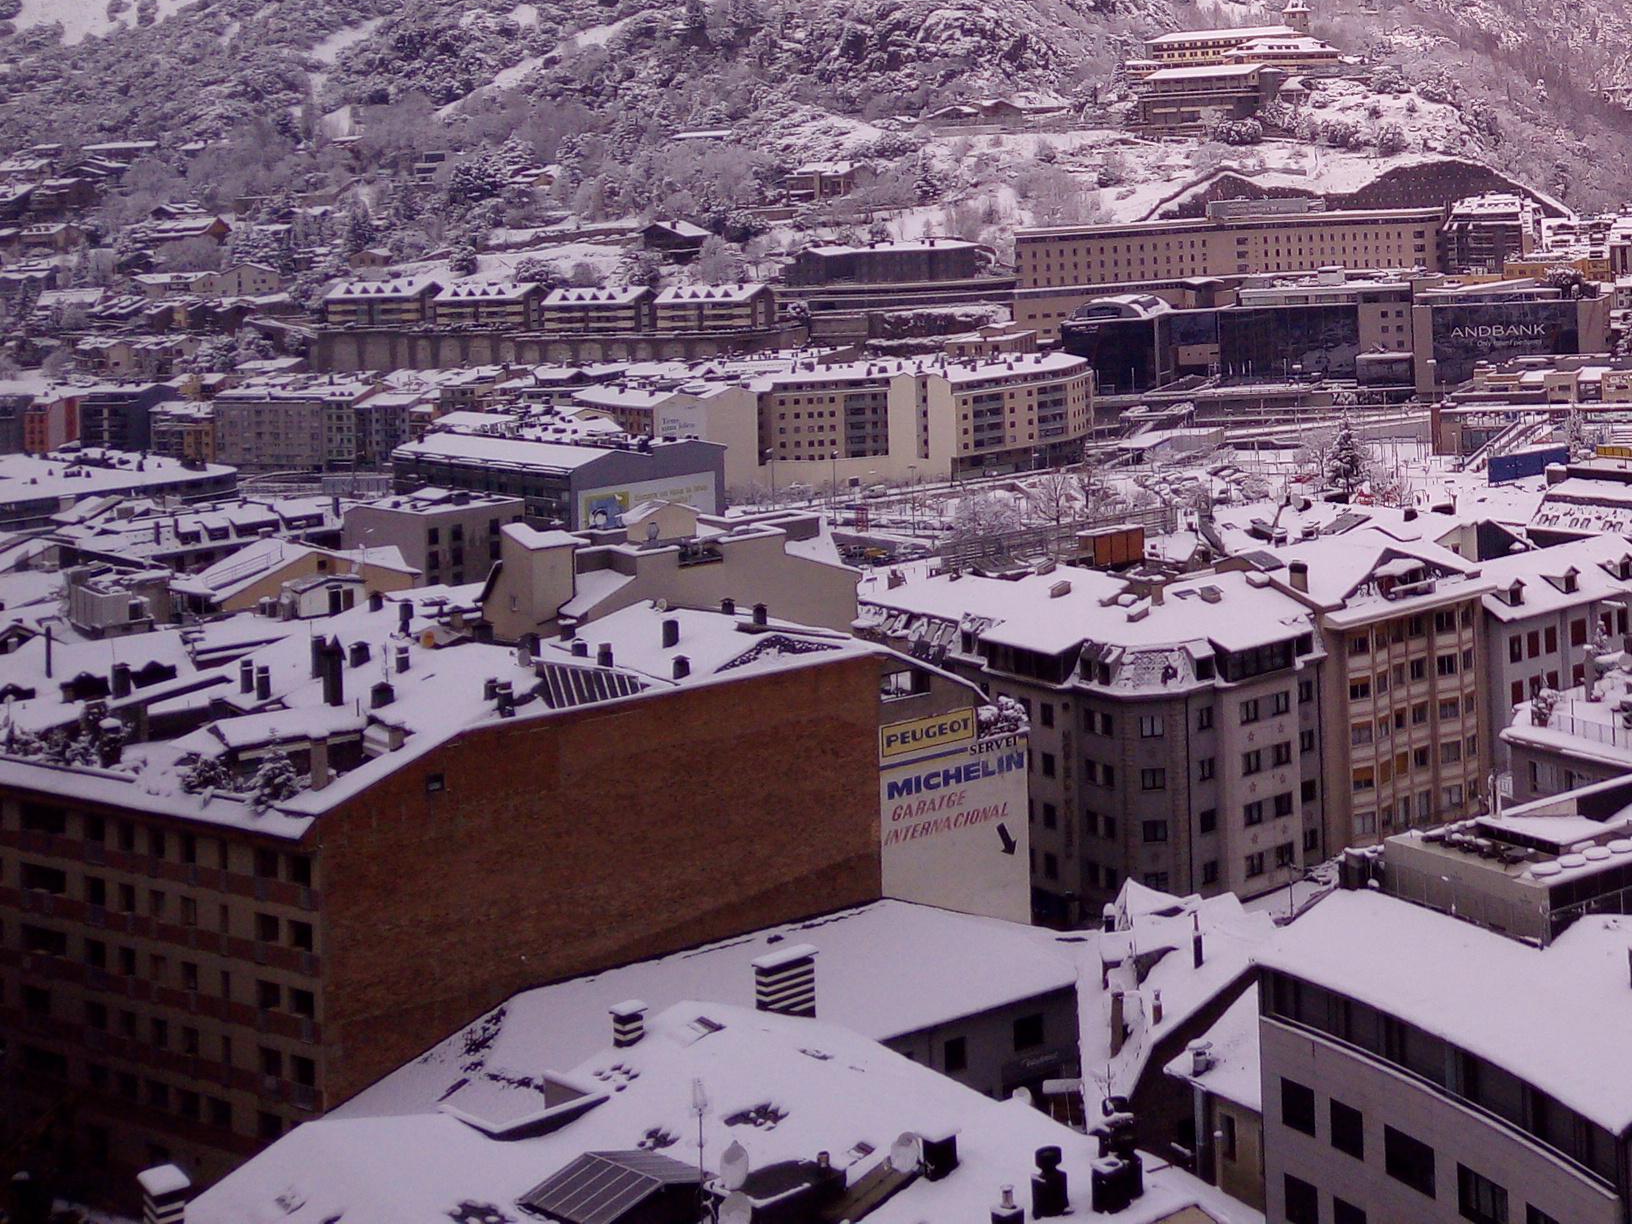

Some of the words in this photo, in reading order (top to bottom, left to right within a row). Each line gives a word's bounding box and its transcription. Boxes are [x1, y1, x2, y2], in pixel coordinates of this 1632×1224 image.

[1451, 324, 1545, 338] ANDBANK
[885, 717, 971, 749] PEUGEOT
[886, 752, 1025, 801] MICHELIN
[892, 790, 967, 822] GARATGE
[883, 802, 1009, 846] INTERNACIONAL
